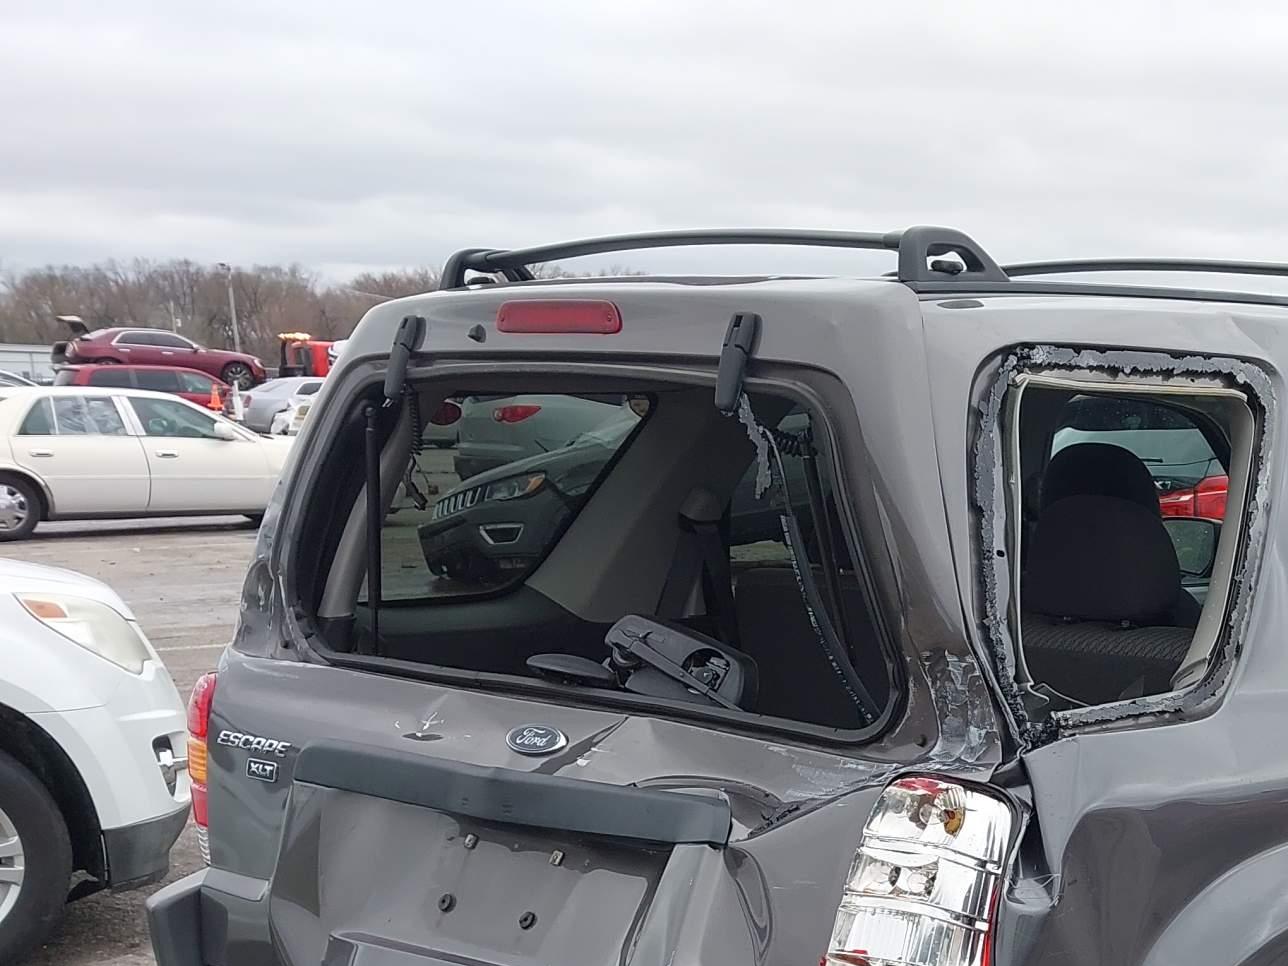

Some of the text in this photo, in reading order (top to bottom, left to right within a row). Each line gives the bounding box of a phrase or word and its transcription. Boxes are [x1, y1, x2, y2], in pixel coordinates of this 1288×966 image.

[217, 729, 292, 758] ESCAPE
[516, 727, 552, 746] Ford
[249, 762, 274, 777] XLT
